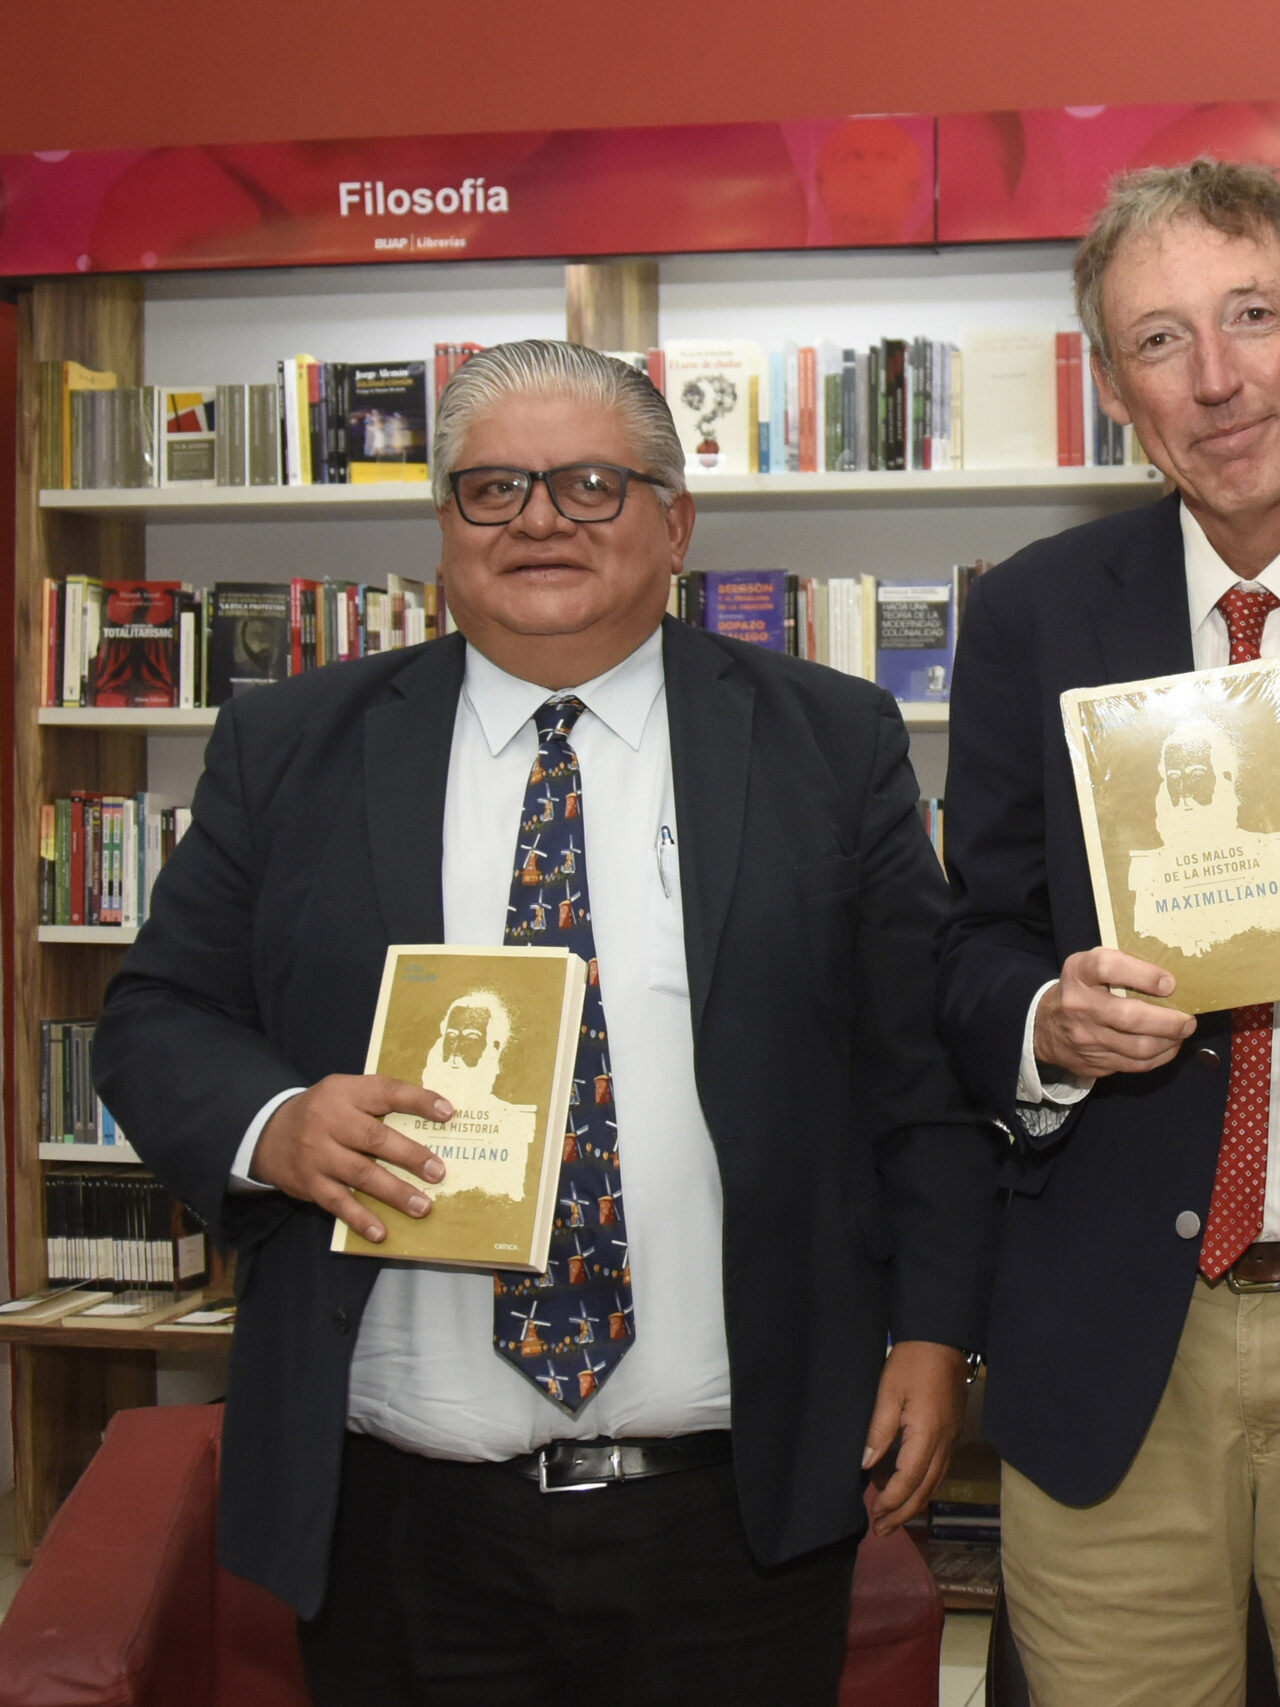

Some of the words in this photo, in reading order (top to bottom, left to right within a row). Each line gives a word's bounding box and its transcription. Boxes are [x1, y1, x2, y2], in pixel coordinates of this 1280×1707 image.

[339, 177, 510, 217] Filosofía
[374, 238, 409, 250] BUAP
[416, 237, 466, 249] Librerías
[1175, 854, 1199, 867] LOS
[1202, 846, 1244, 862] MALOS
[1164, 871, 1180, 883] DE
[1184, 868, 1200, 880] LA
[1203, 858, 1261, 877] HISTORIA
[1155, 880, 1279, 913] MAXIMILIANO
[414, 1119, 429, 1130] DE
[432, 1121, 446, 1131] LA
[449, 1123, 500, 1134] HISTORIA
